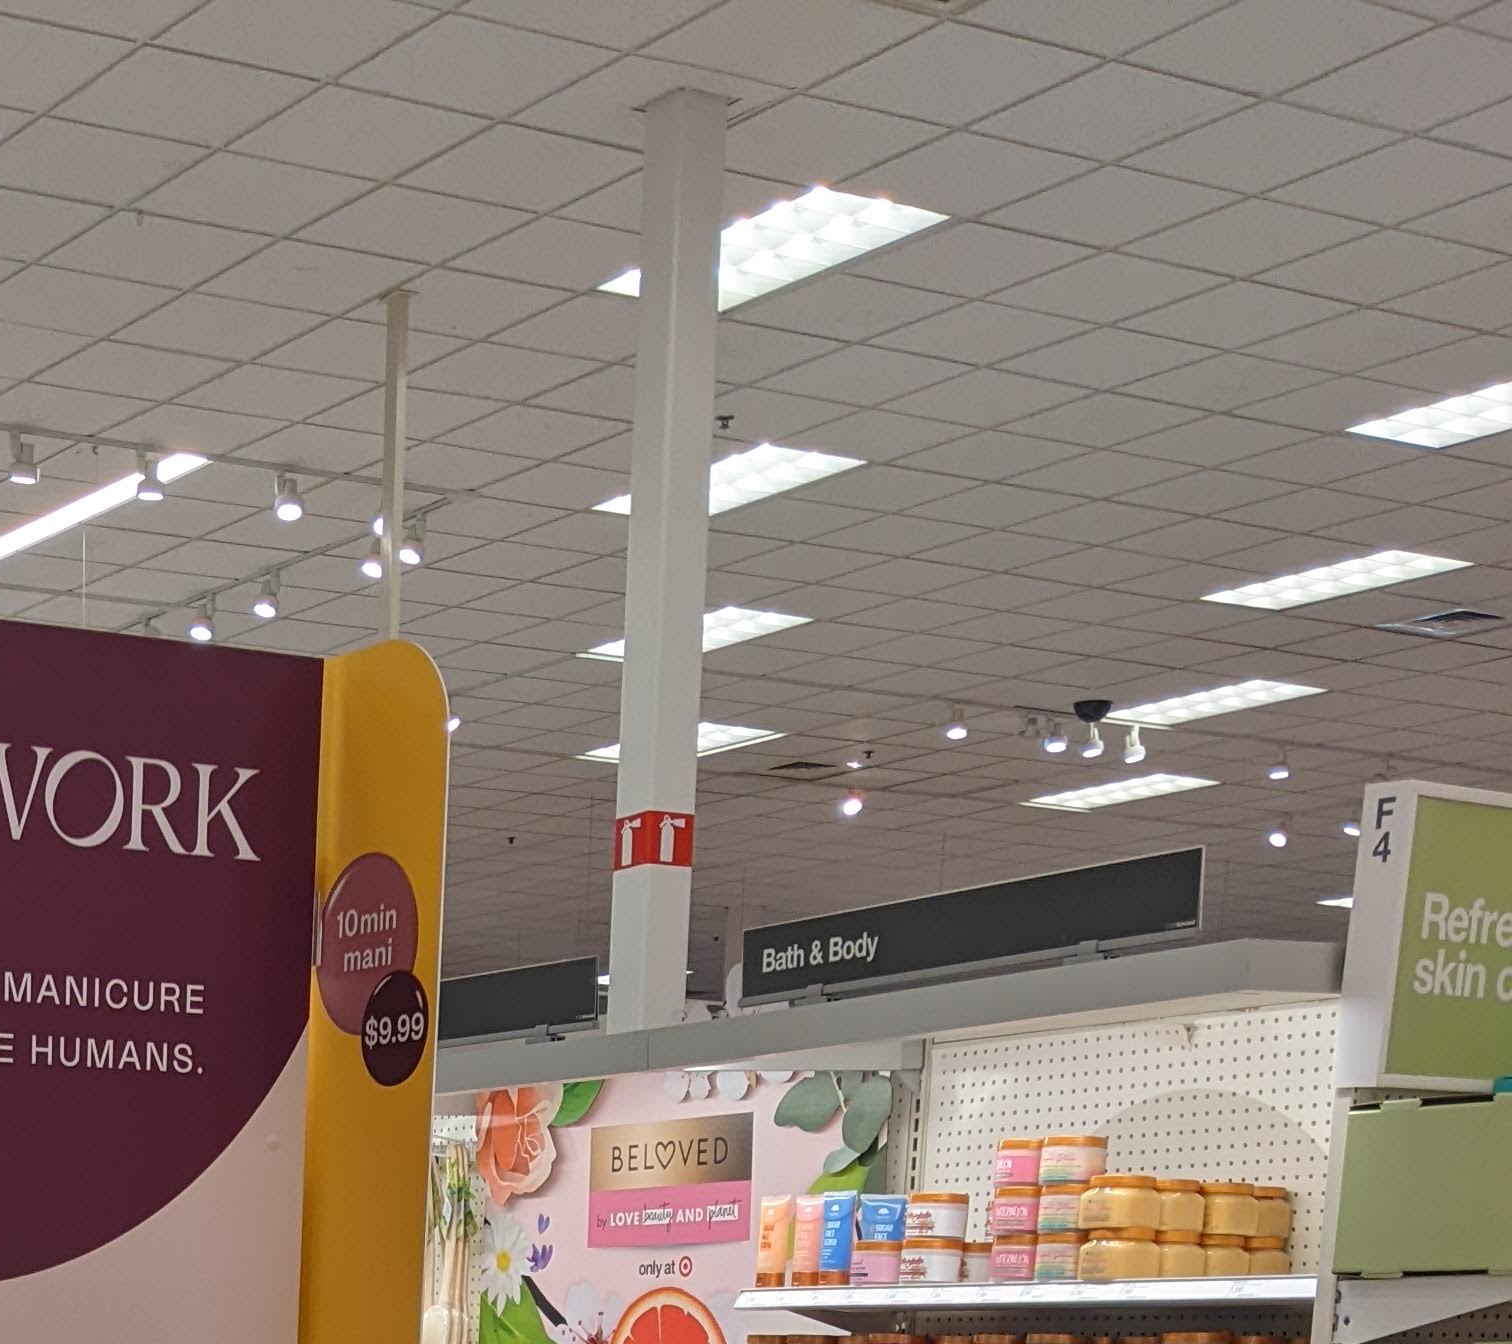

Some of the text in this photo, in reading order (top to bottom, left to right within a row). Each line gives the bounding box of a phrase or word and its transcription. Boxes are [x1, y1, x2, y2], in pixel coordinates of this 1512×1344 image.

[1375, 796, 1397, 829] F
[1372, 831, 1392, 863] 4
[337, 903, 397, 939] 10min
[344, 937, 393, 973] mani
[762, 931, 879, 973] Bath & Body
[1413, 949, 1486, 999] skin
[3, 971, 206, 1016] MANICURE
[364, 1012, 425, 1050] $9.99
[29, 1036, 204, 1076] HUMANS.
[596, 1215, 607, 1231] by
[609, 1211, 640, 1227] LOVE
[643, 1202, 675, 1233] beauty
[675, 1207, 704, 1224] AND
[638, 1260, 676, 1279] only at
